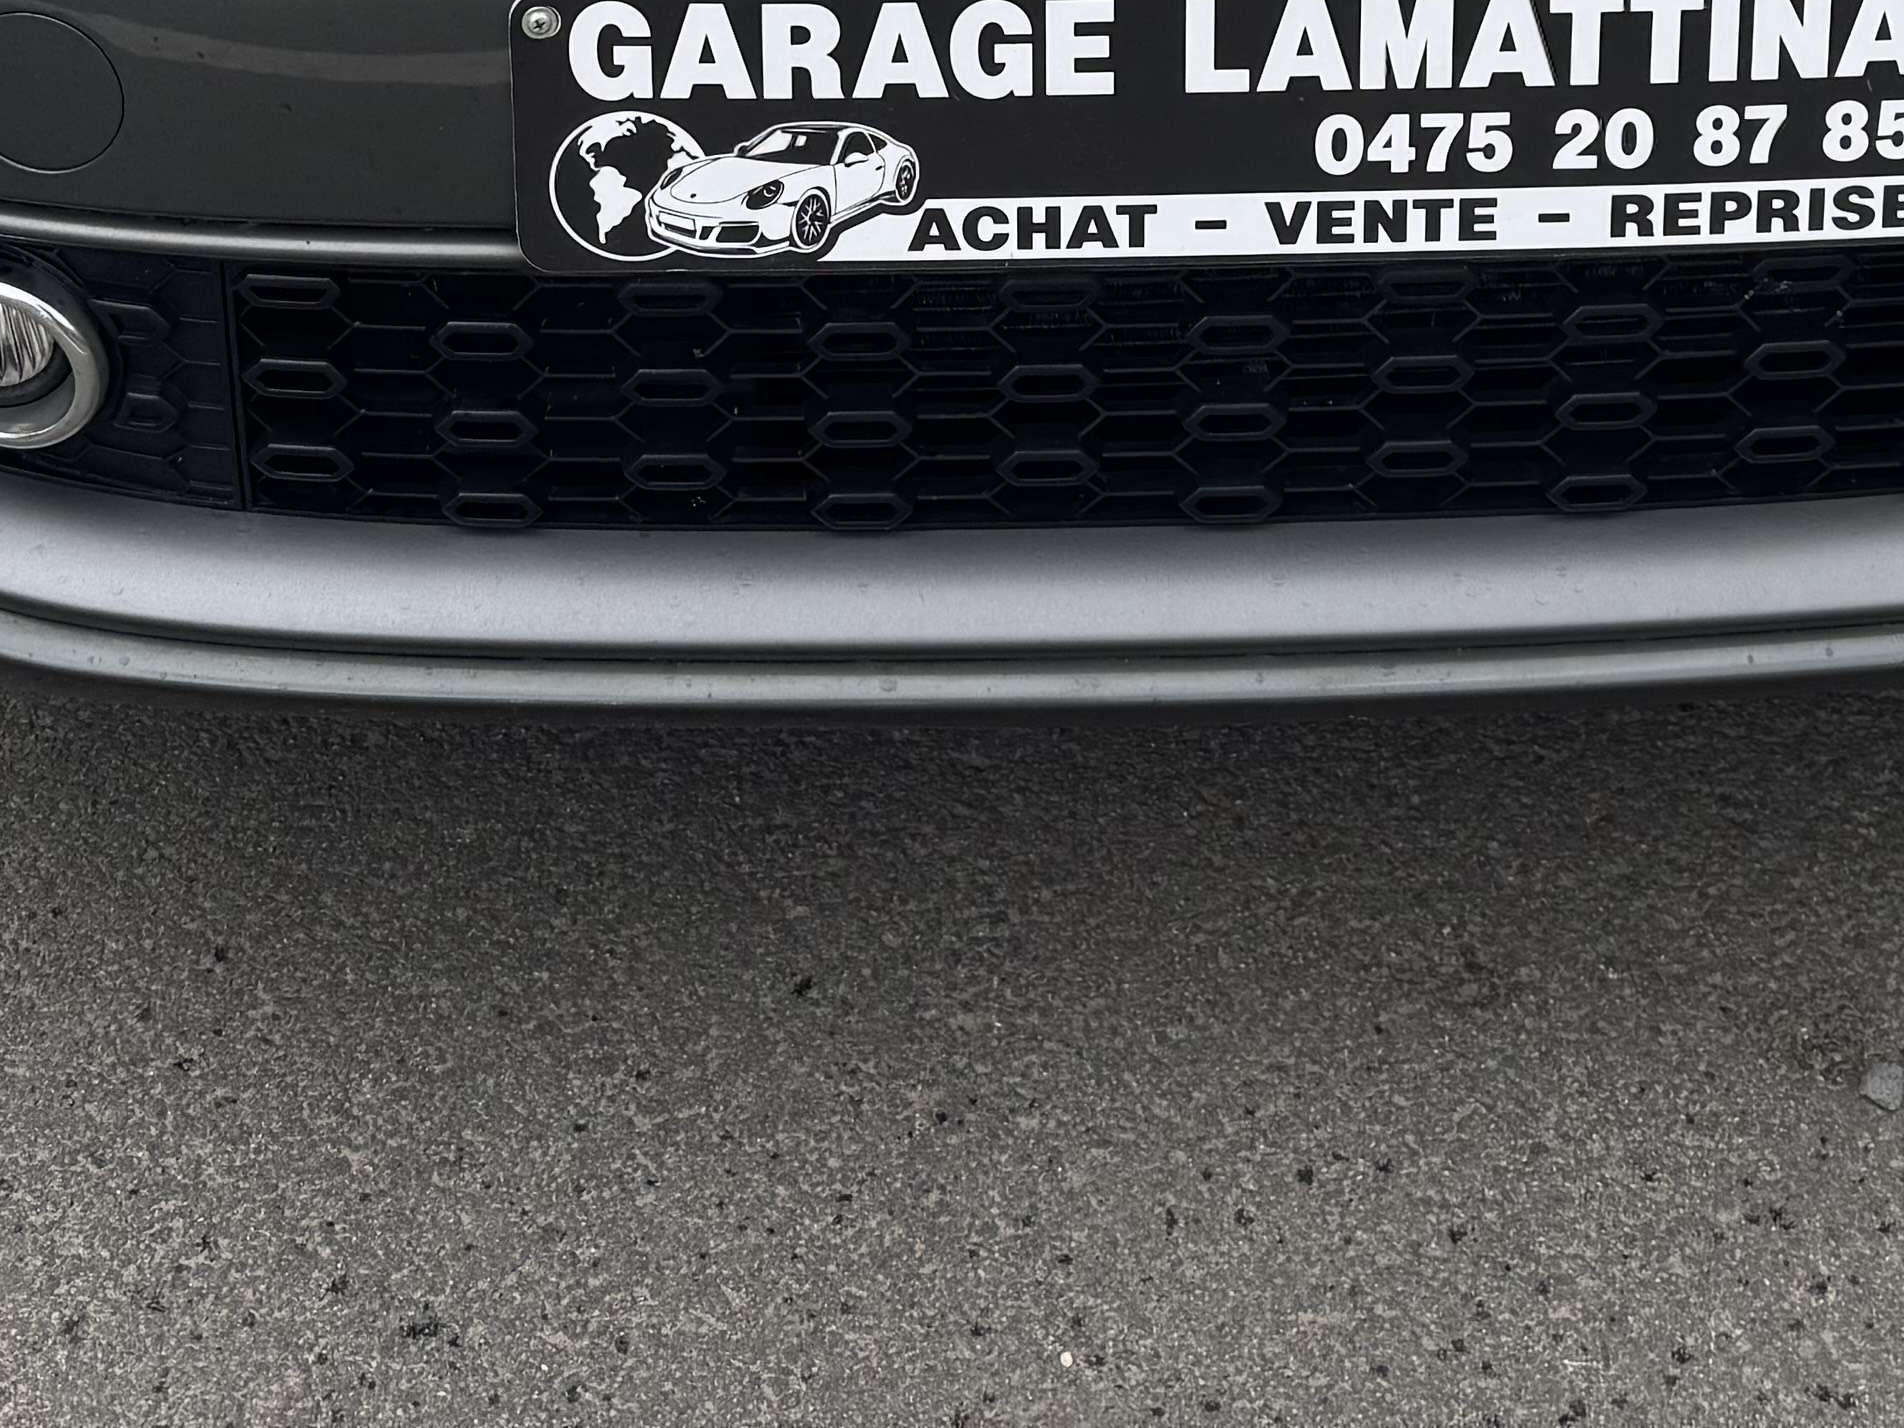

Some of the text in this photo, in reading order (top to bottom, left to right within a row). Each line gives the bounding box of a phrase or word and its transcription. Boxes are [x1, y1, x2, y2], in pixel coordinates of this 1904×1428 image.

[1313, 111, 1513, 175] 0475
[1552, 108, 1654, 171] 20
[1693, 103, 1789, 166] 87
[907, 204, 1158, 252] ACHAT
[1265, 197, 1498, 245] VENTE
